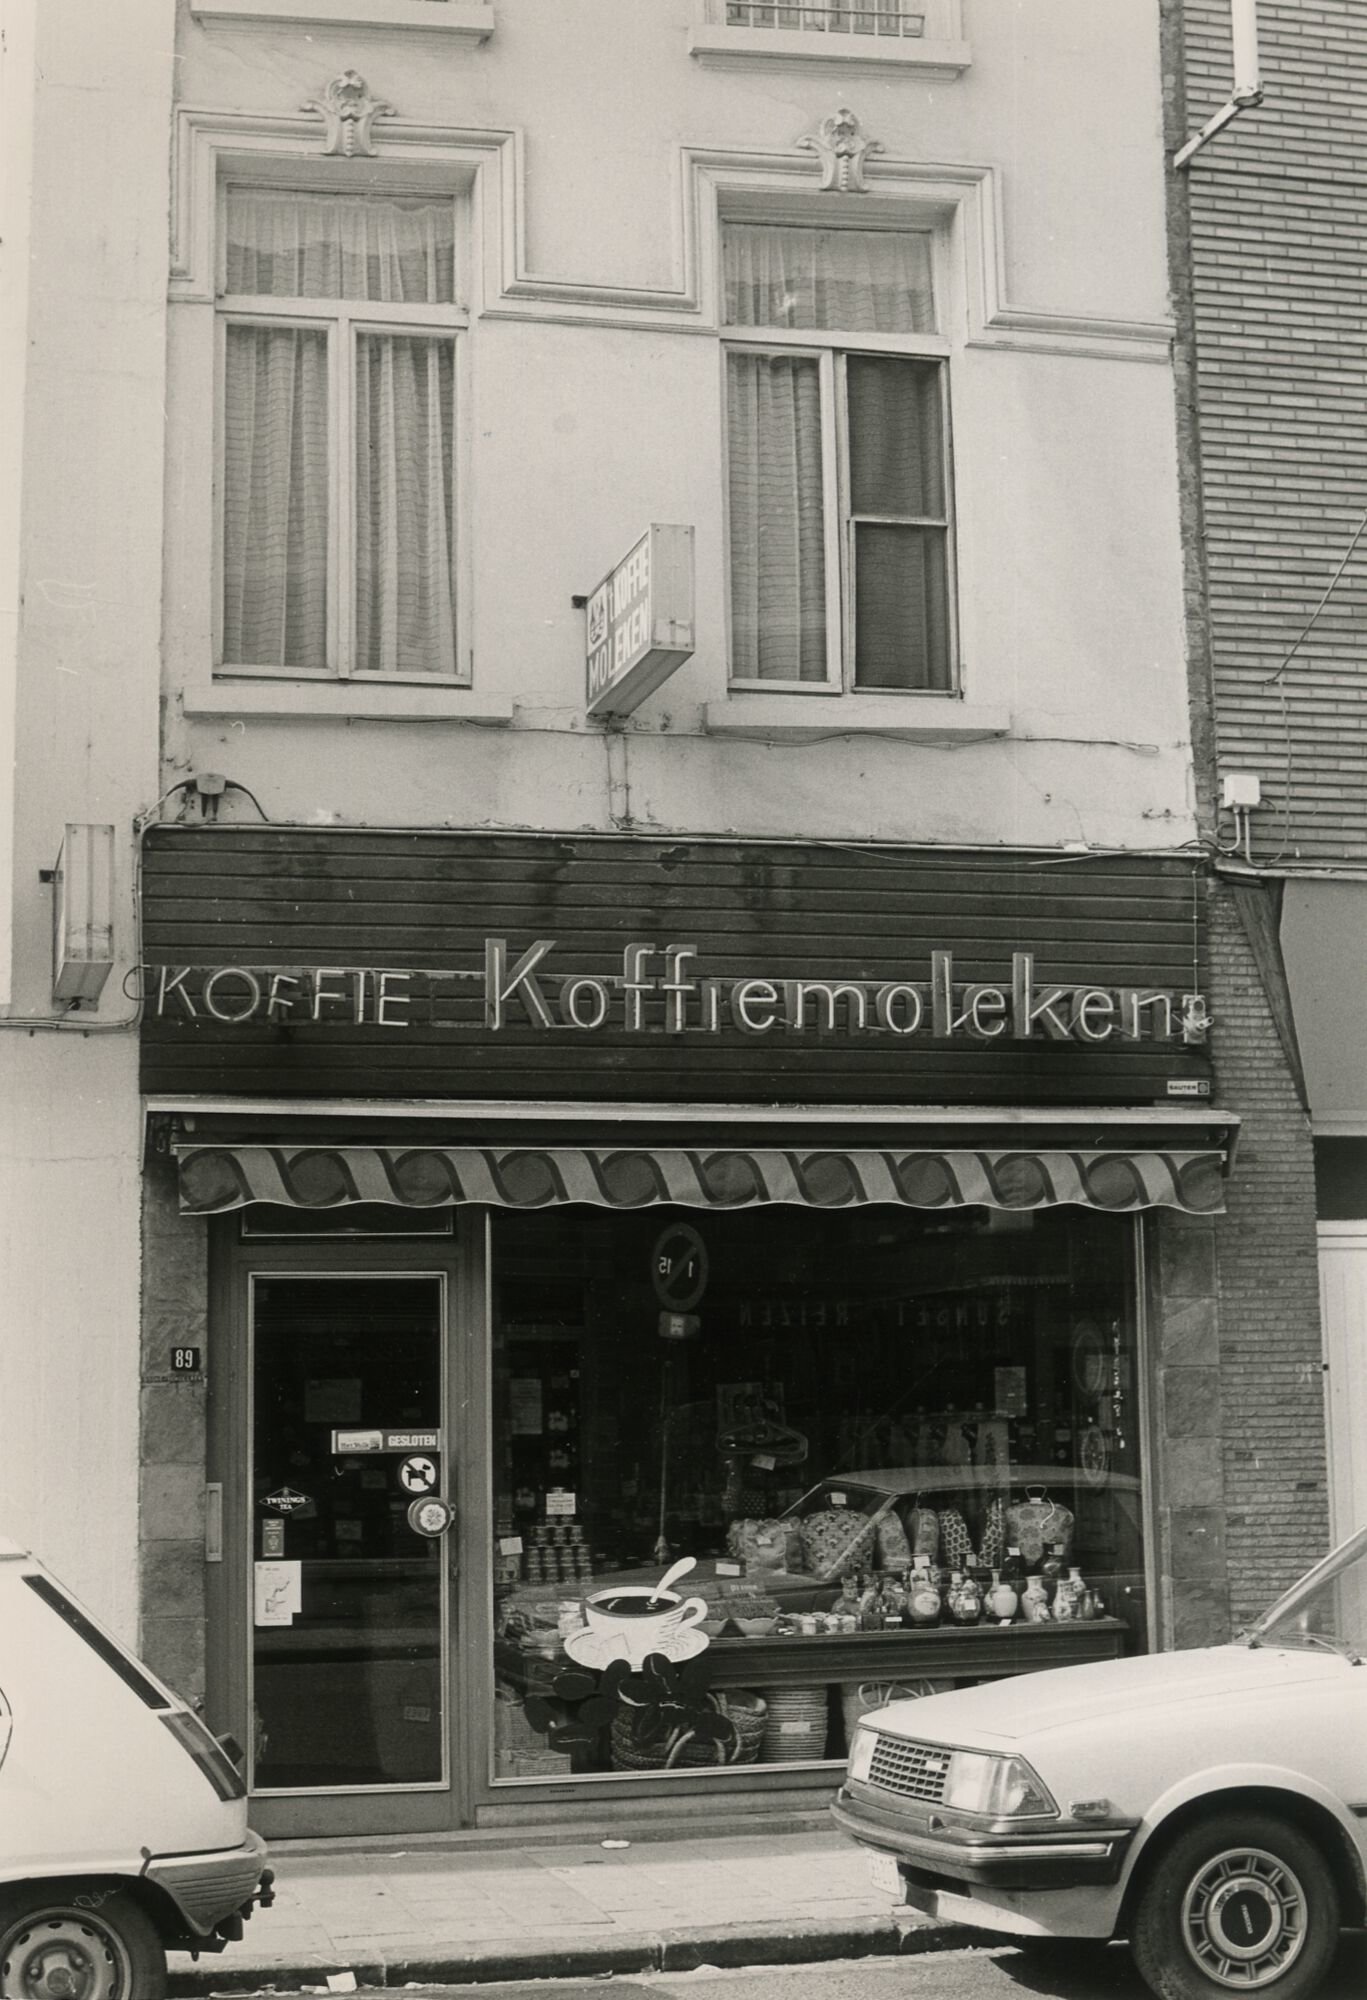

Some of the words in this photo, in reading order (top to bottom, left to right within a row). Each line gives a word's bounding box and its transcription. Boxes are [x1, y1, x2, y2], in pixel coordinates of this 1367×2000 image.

[613, 543, 649, 618] KOFFIE
[589, 598, 649, 698] MOLEKEN
[156, 965, 412, 1028] KOFFIE
[484, 938, 1174, 1042] Koffiemoleken
[175, 1348, 194, 1369] 89
[388, 1435, 436, 1446] GESLOTEN
[267, 1497, 305, 1505] TWININGS
